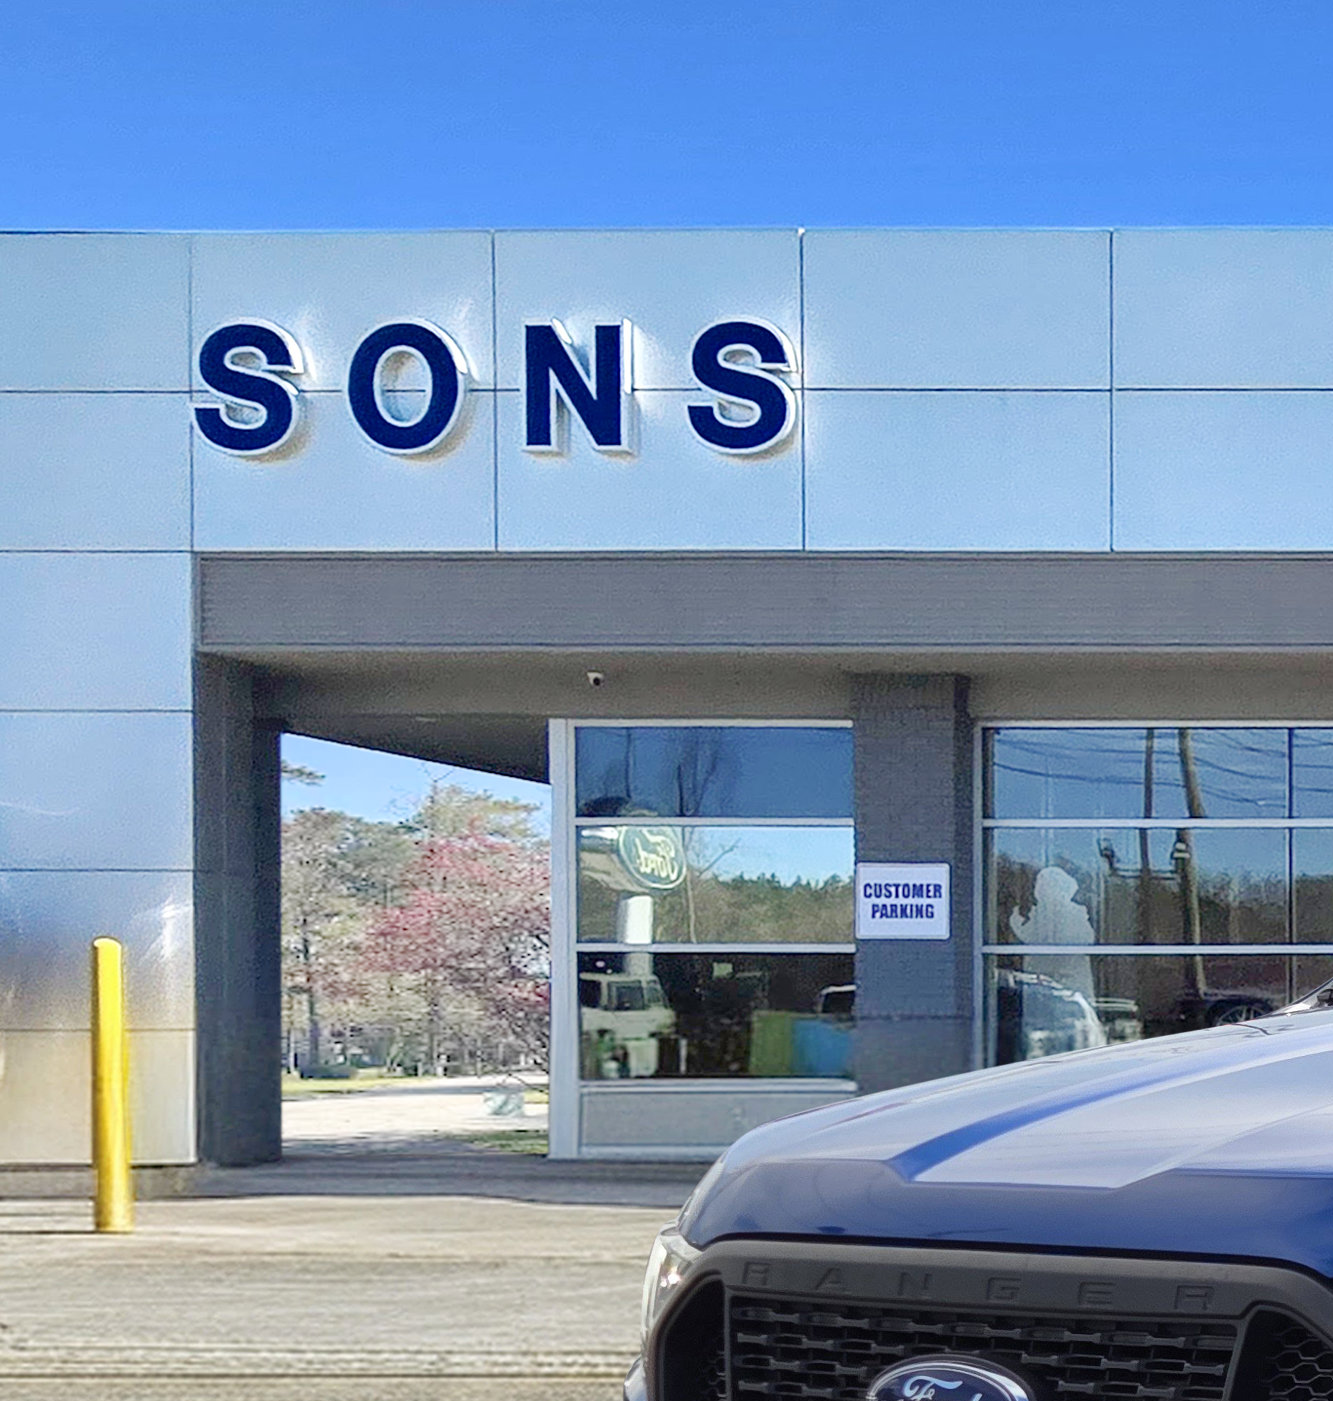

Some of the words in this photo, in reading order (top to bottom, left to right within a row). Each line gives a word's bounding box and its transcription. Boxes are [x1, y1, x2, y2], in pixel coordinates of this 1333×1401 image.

[194, 319, 796, 454] SONS
[863, 882, 943, 899] CUSTOMER
[871, 903, 935, 919] PARKING
[742, 1260, 1216, 1311] RANGER
